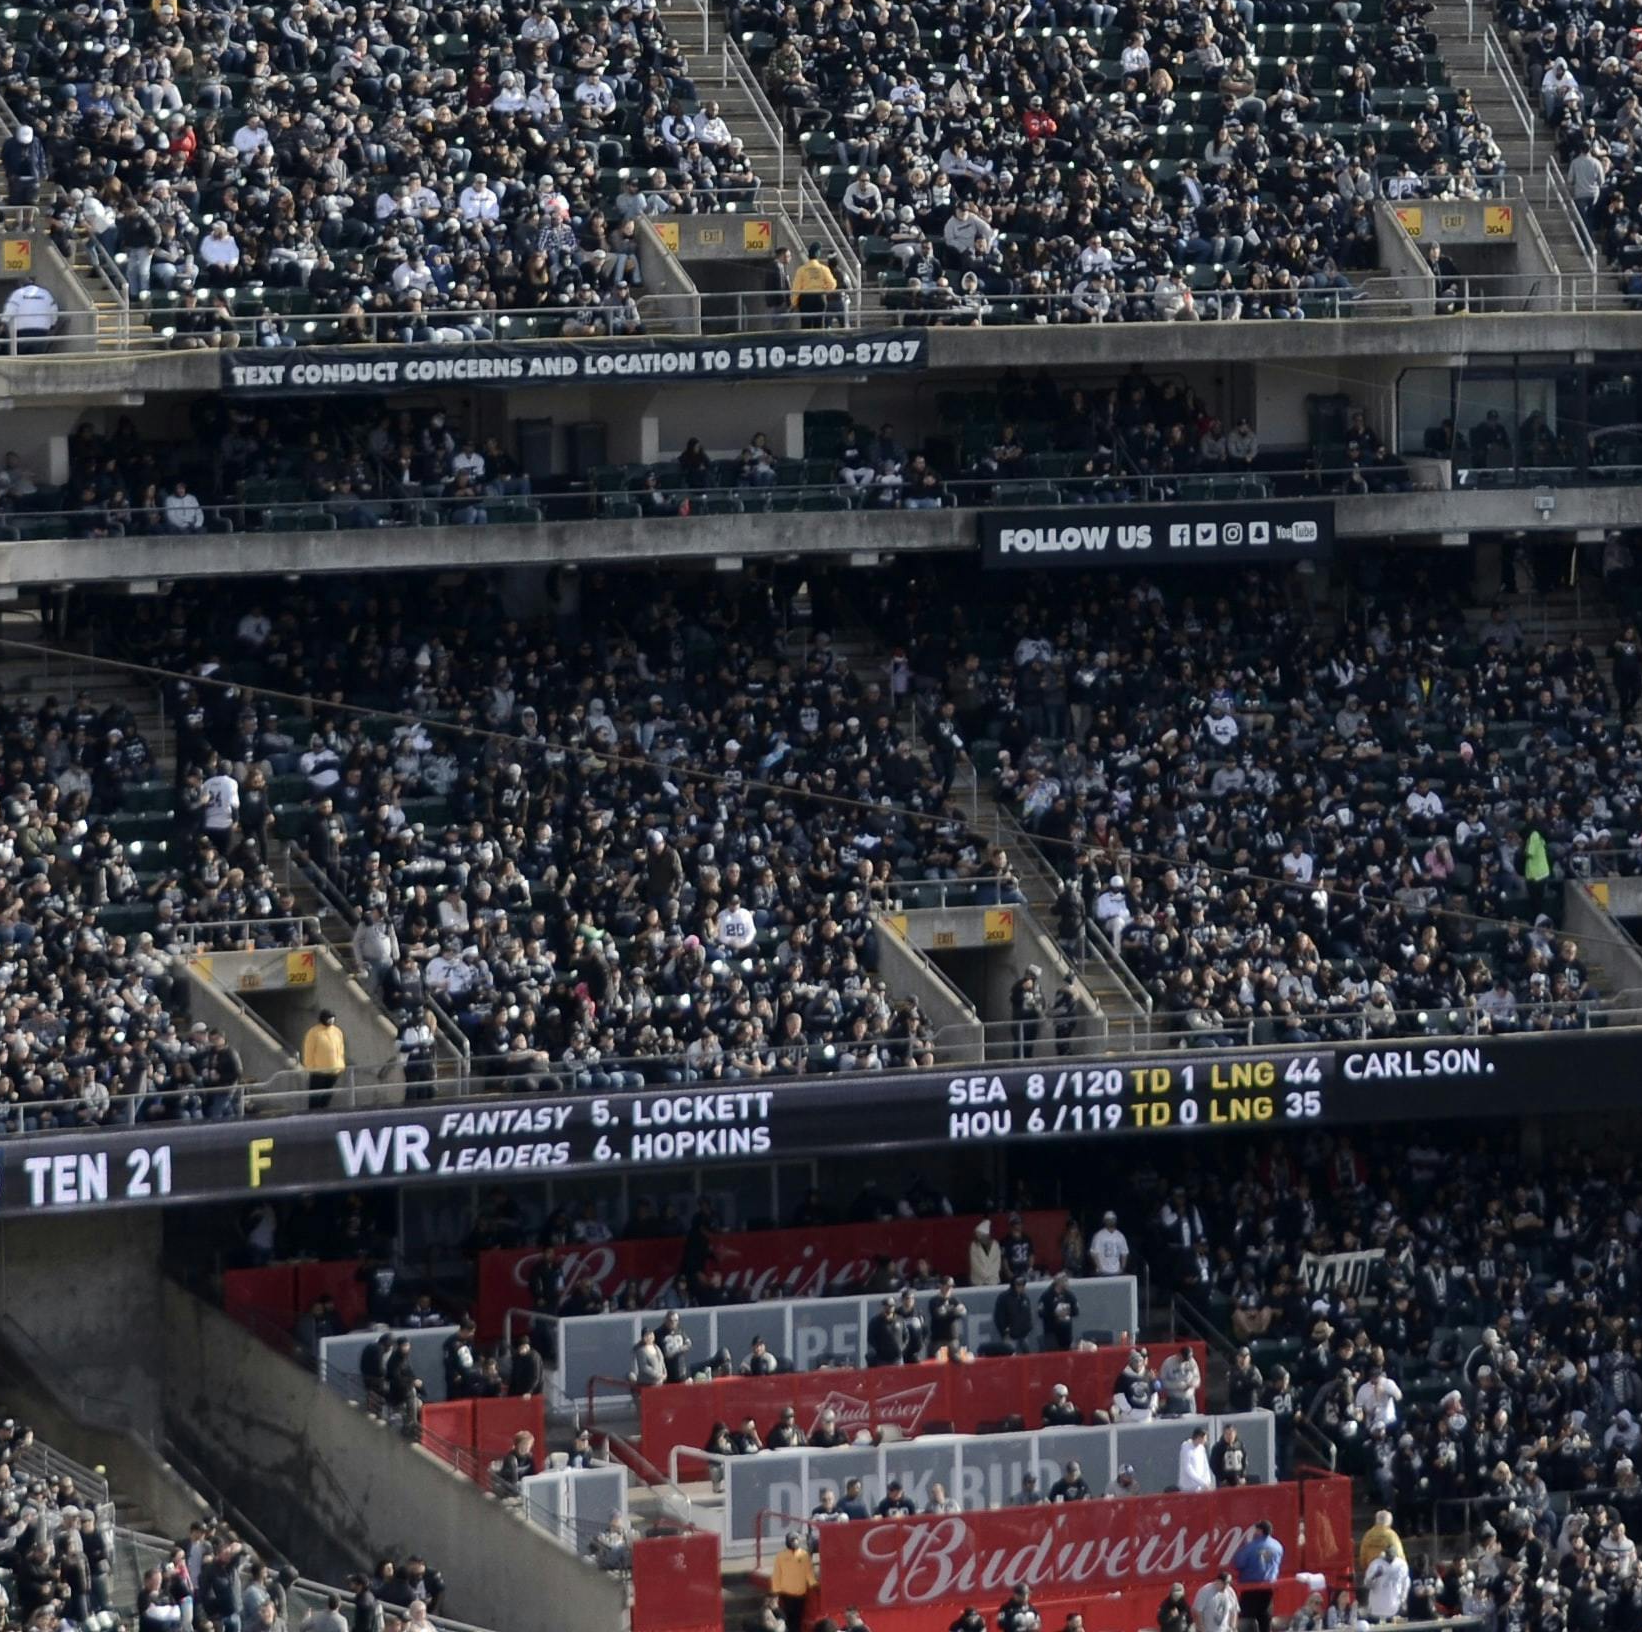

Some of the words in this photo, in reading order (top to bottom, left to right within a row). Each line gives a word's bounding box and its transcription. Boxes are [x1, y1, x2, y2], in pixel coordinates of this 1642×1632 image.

[703, 231, 721, 242] EXIT
[746, 240, 764, 249] 303
[1486, 226, 1504, 235] 304
[232, 365, 286, 386] TEXT
[290, 361, 399, 385] CONDUCT
[404, 357, 523, 381] CONCERNS
[527, 356, 578, 377] AND
[584, 351, 696, 375] LOCATION
[701, 350, 731, 371] TO
[737, 340, 921, 369] 510-500-8787
[1000, 526, 1110, 553] FOLLOW
[1117, 525, 1152, 549] US
[948, 1076, 1007, 1105] SEA
[1130, 1068, 1171, 1093] TD
[1181, 1065, 1194, 1091] 1
[1211, 1061, 1275, 1089] LNG
[1284, 1057, 1322, 1084] 44
[1343, 1047, 1495, 1080] CARLSON.
[437, 1103, 573, 1138] FANTASY
[591, 1099, 619, 1127] 5.
[633, 1090, 774, 1126] LOCKETT
[950, 1109, 1012, 1139] HOU
[1131, 1102, 1171, 1127] TD
[1179, 1098, 1198, 1127] 0
[1210, 1096, 1273, 1124] LNG
[1286, 1090, 1321, 1118] 35
[25, 1152, 108, 1206] TEN
[127, 1145, 172, 1198] 21
[250, 1137, 274, 1187] F
[337, 1124, 431, 1177] WR
[437, 1141, 572, 1175] LEADERS
[593, 1135, 622, 1164] 6.
[631, 1126, 771, 1161] HOPKINS
[861, 1514, 1255, 1604] Budweiser
